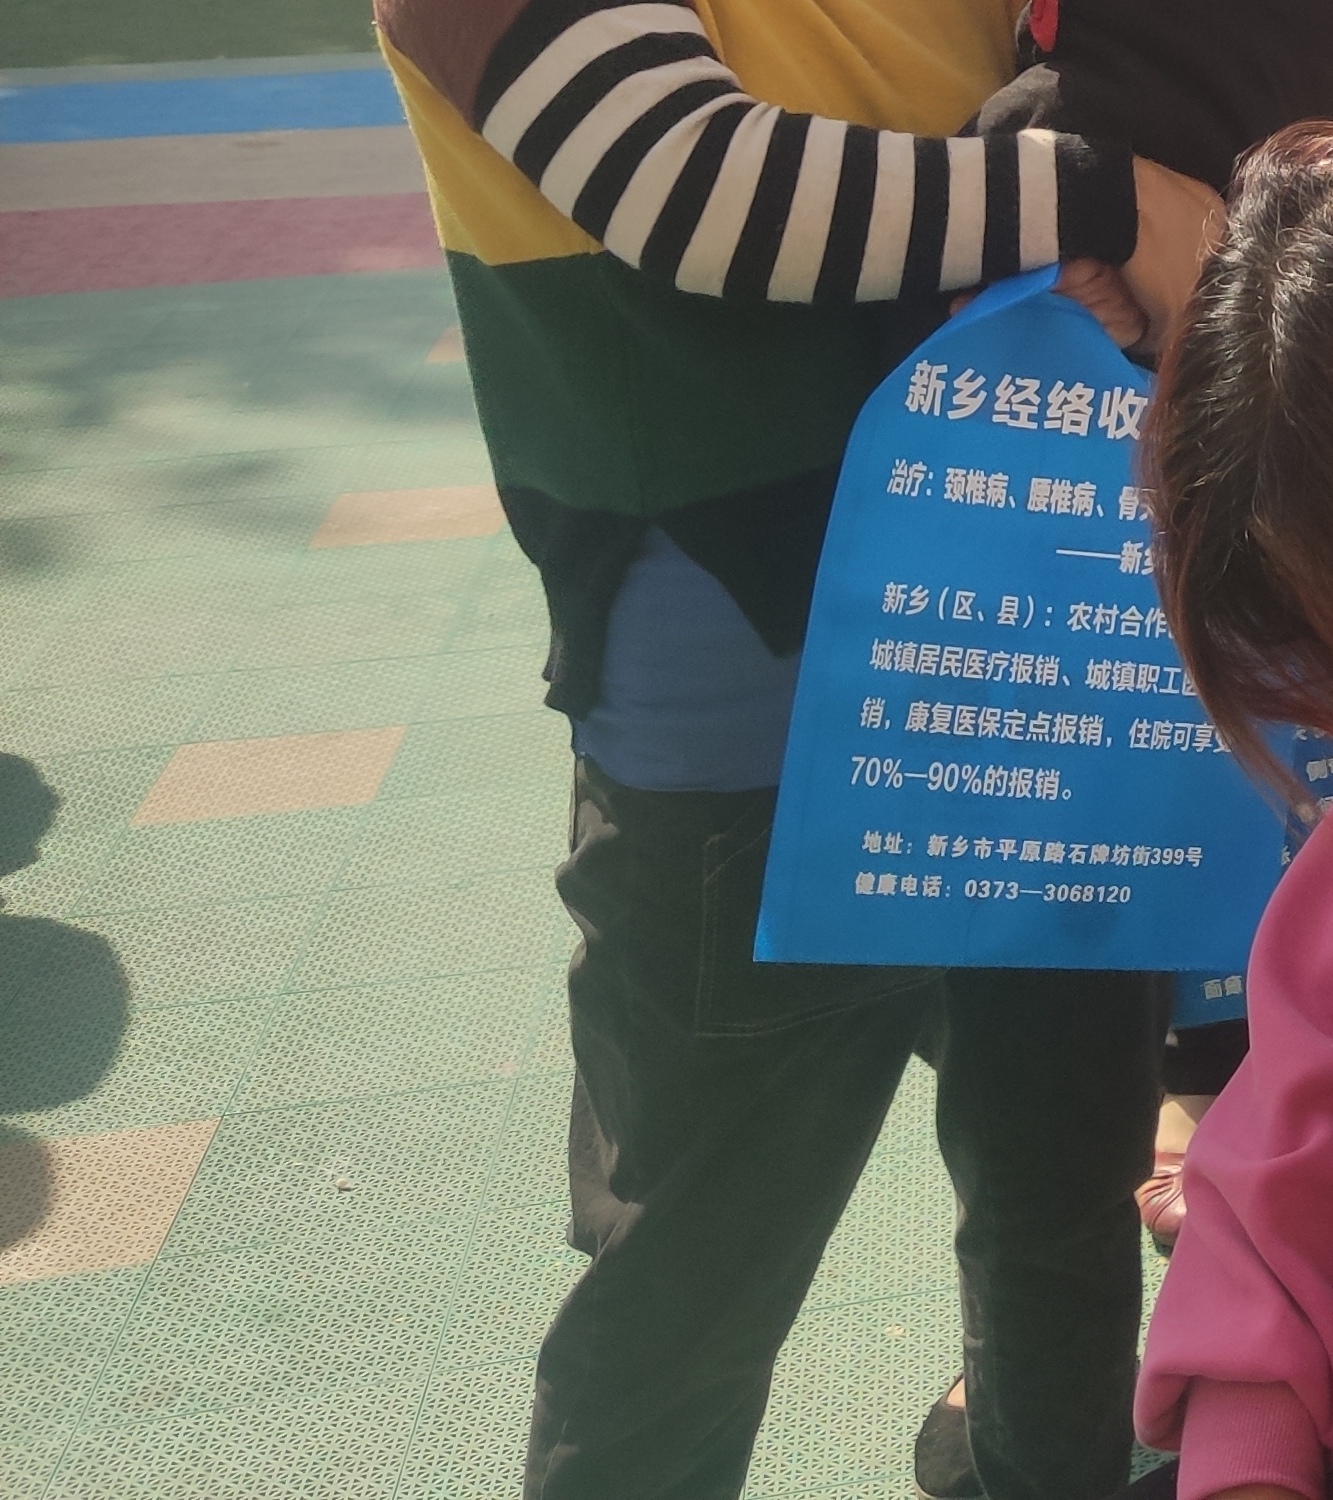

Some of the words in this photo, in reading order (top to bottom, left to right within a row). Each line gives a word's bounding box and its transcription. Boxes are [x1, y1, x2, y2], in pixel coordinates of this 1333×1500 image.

[905, 359, 1148, 441] 新乡经络收
[881, 581, 1174, 639] 新乡（区、县）：农村合作
